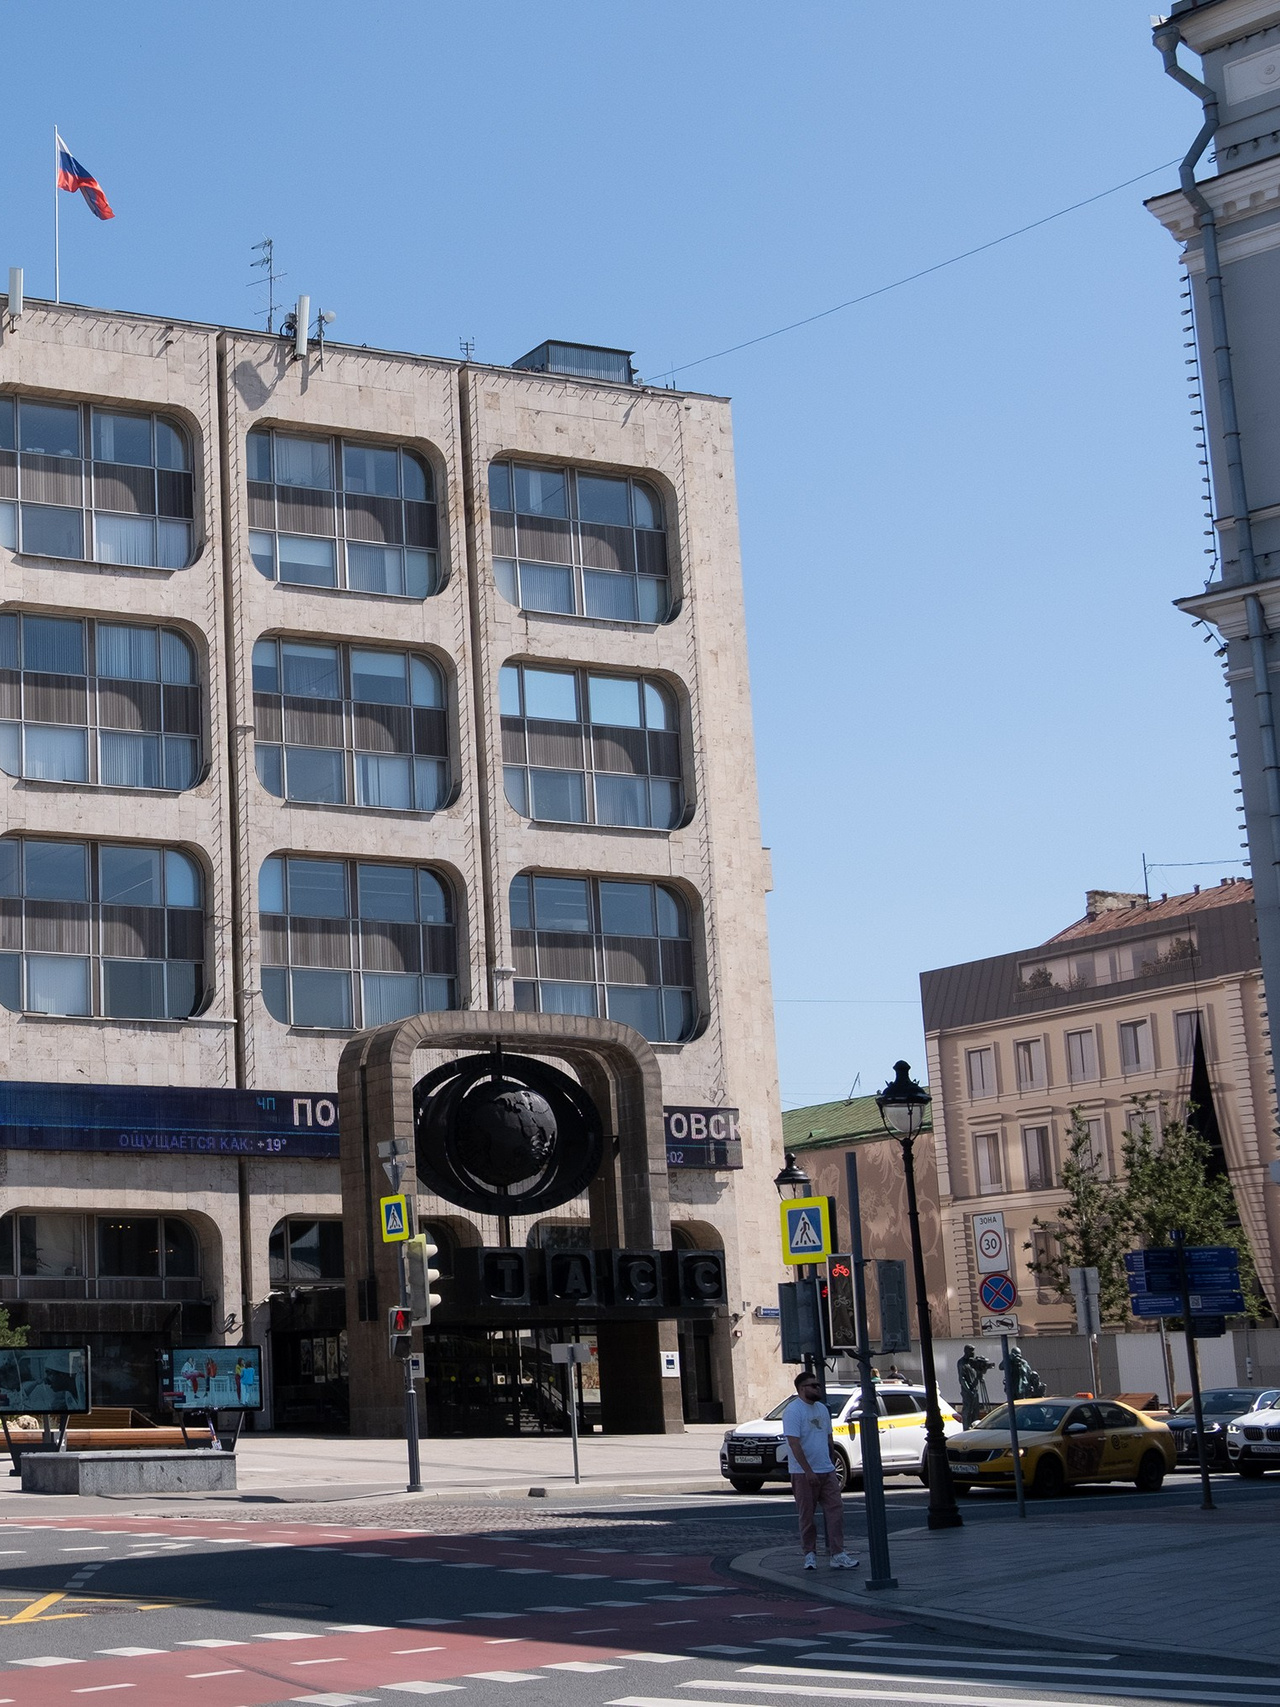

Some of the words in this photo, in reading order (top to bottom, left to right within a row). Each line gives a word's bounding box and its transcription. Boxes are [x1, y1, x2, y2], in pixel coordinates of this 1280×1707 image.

[256, 1096, 276, 1111] ЧП
[292, 1097, 340, 1128] ПО
[663, 1111, 740, 1141] ОВСК
[119, 1134, 215, 1150] ОЩУЩАЕТСЯ
[221, 1136, 253, 1151] КАК:
[257, 1138, 286, 1152] +19°
[979, 1216, 997, 1225] ЗОНА
[984, 1238, 998, 1251] 30
